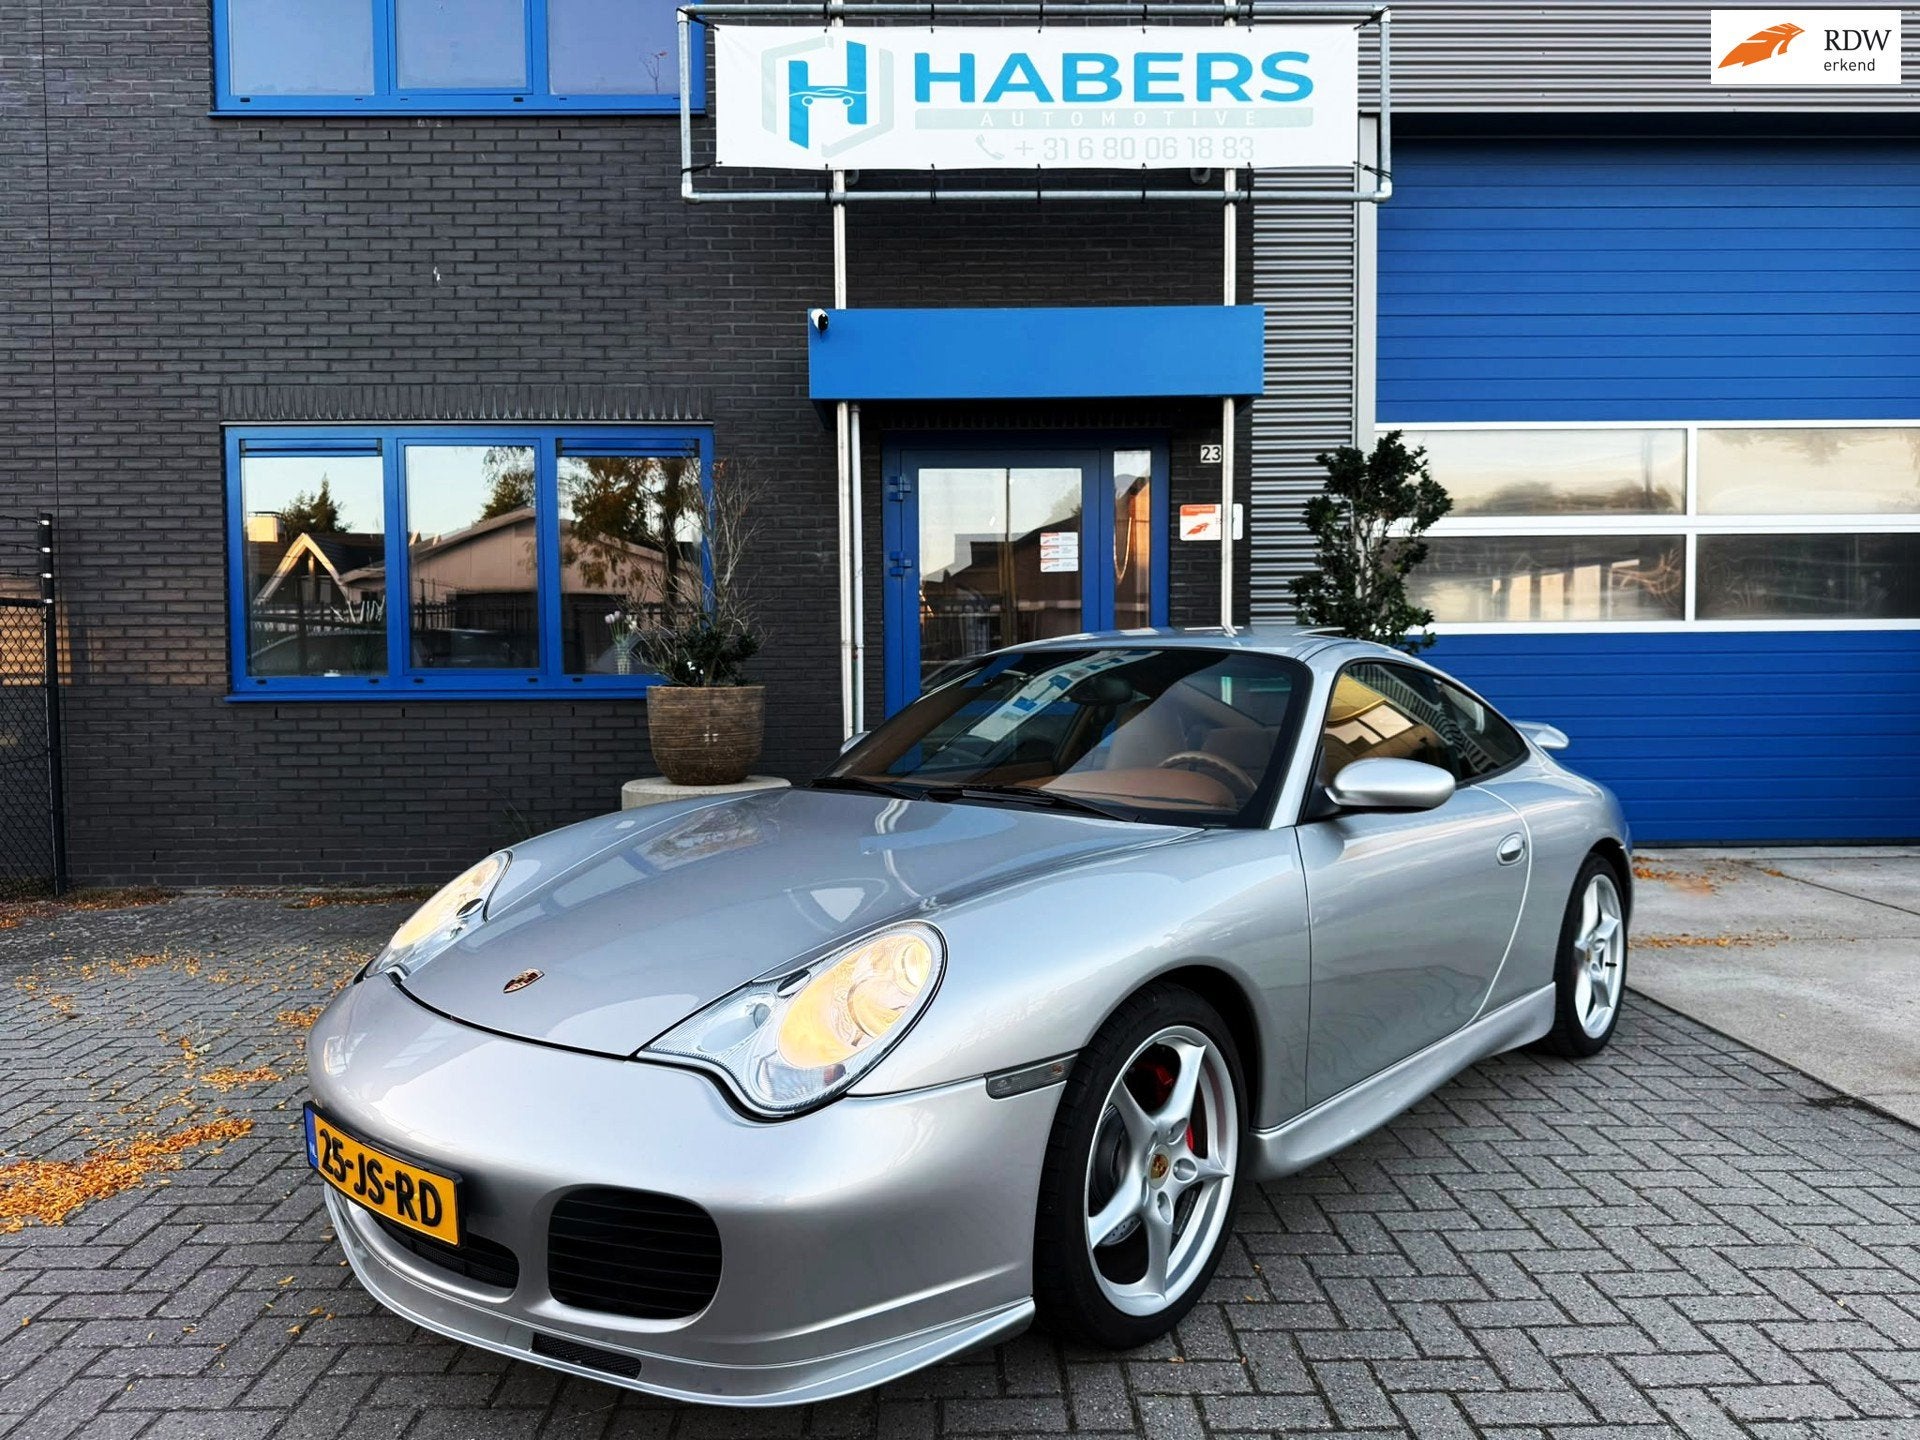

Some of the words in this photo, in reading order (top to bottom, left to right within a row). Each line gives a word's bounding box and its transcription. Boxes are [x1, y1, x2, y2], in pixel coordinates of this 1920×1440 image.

[914, 51, 1314, 103] HABERS
[980, 110, 1255, 127] AUTOMOTIVE
[1201, 446, 1221, 461] 23
[319, 1128, 443, 1228] 25-JS-RD
